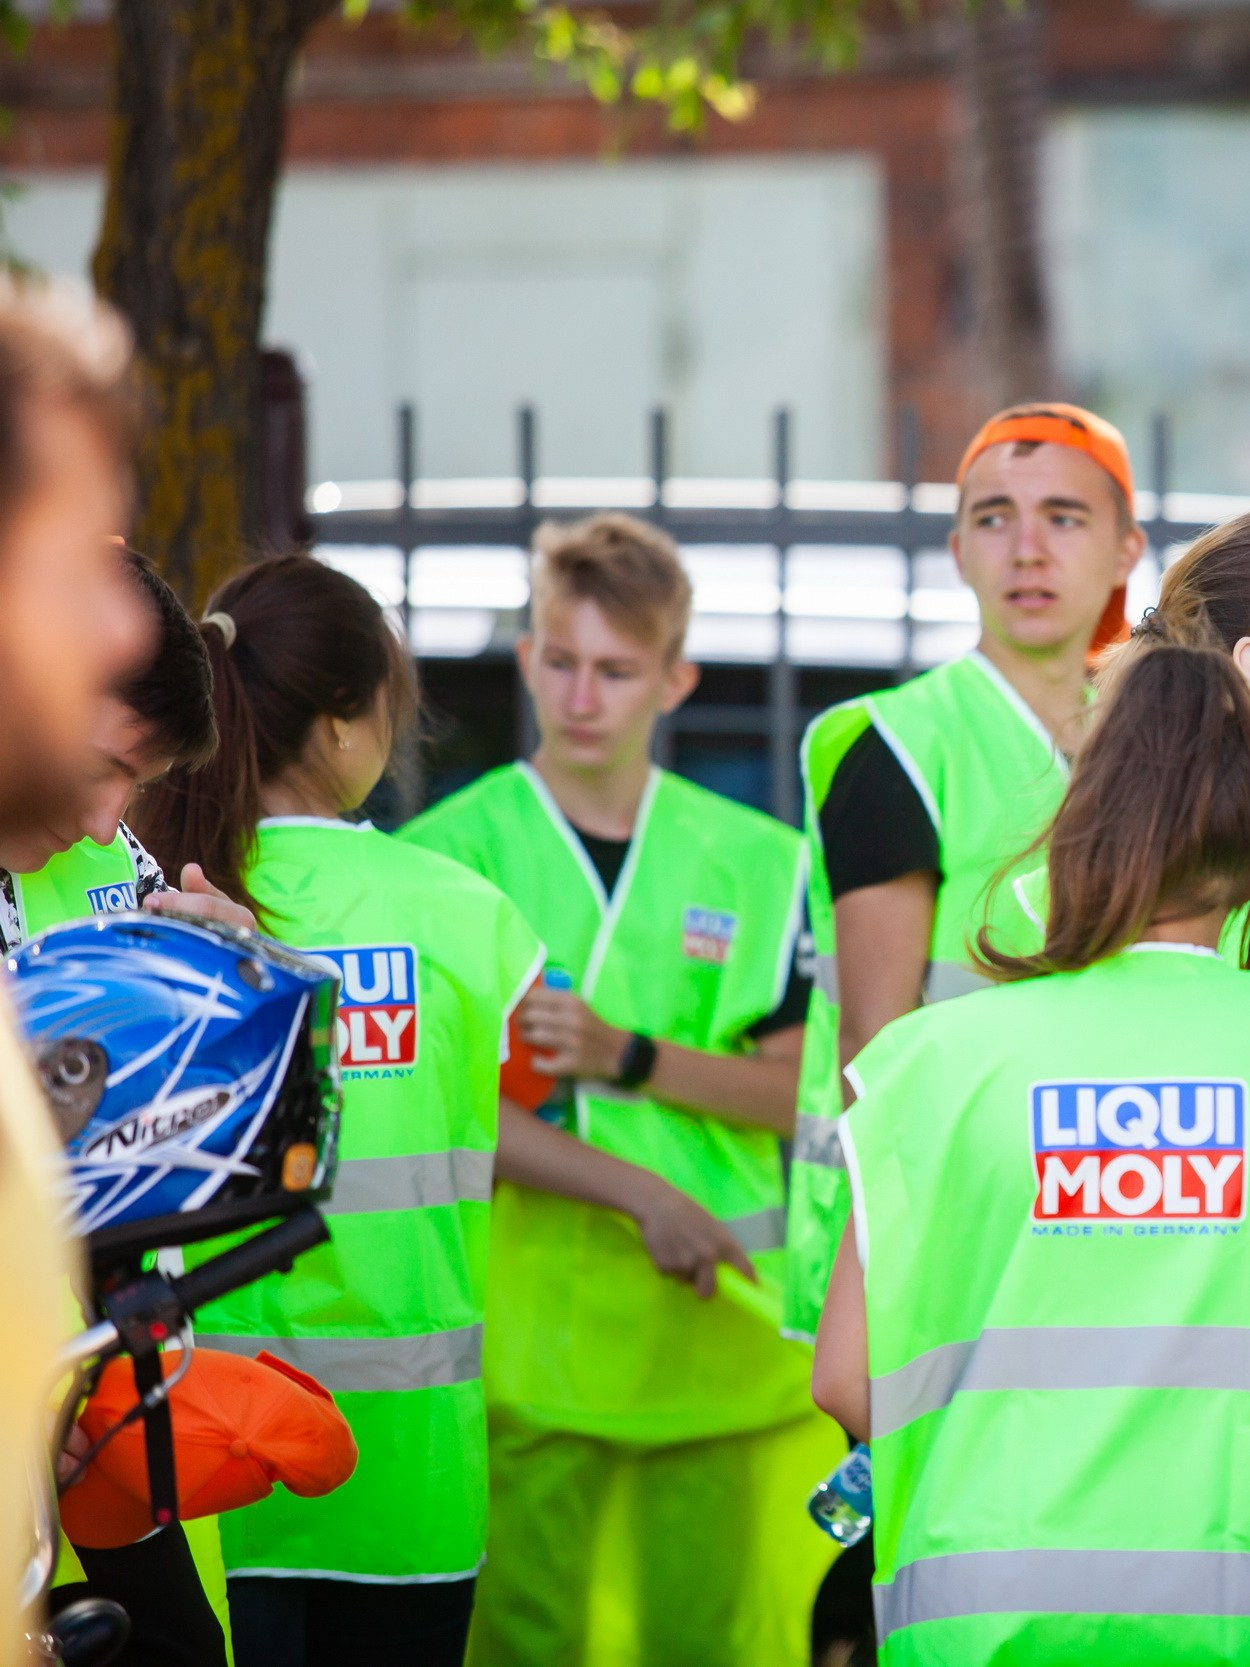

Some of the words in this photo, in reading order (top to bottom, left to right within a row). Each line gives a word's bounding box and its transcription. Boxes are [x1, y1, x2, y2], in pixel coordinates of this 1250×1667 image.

[341, 1069, 414, 1081] ERMANY
[1041, 1085, 1236, 1150] LIQUI
[1041, 1153, 1243, 1216] MOLY
[1031, 1225, 1094, 1237] MADE
[1102, 1226, 1123, 1236] IN
[1132, 1225, 1241, 1237] GERMANY
